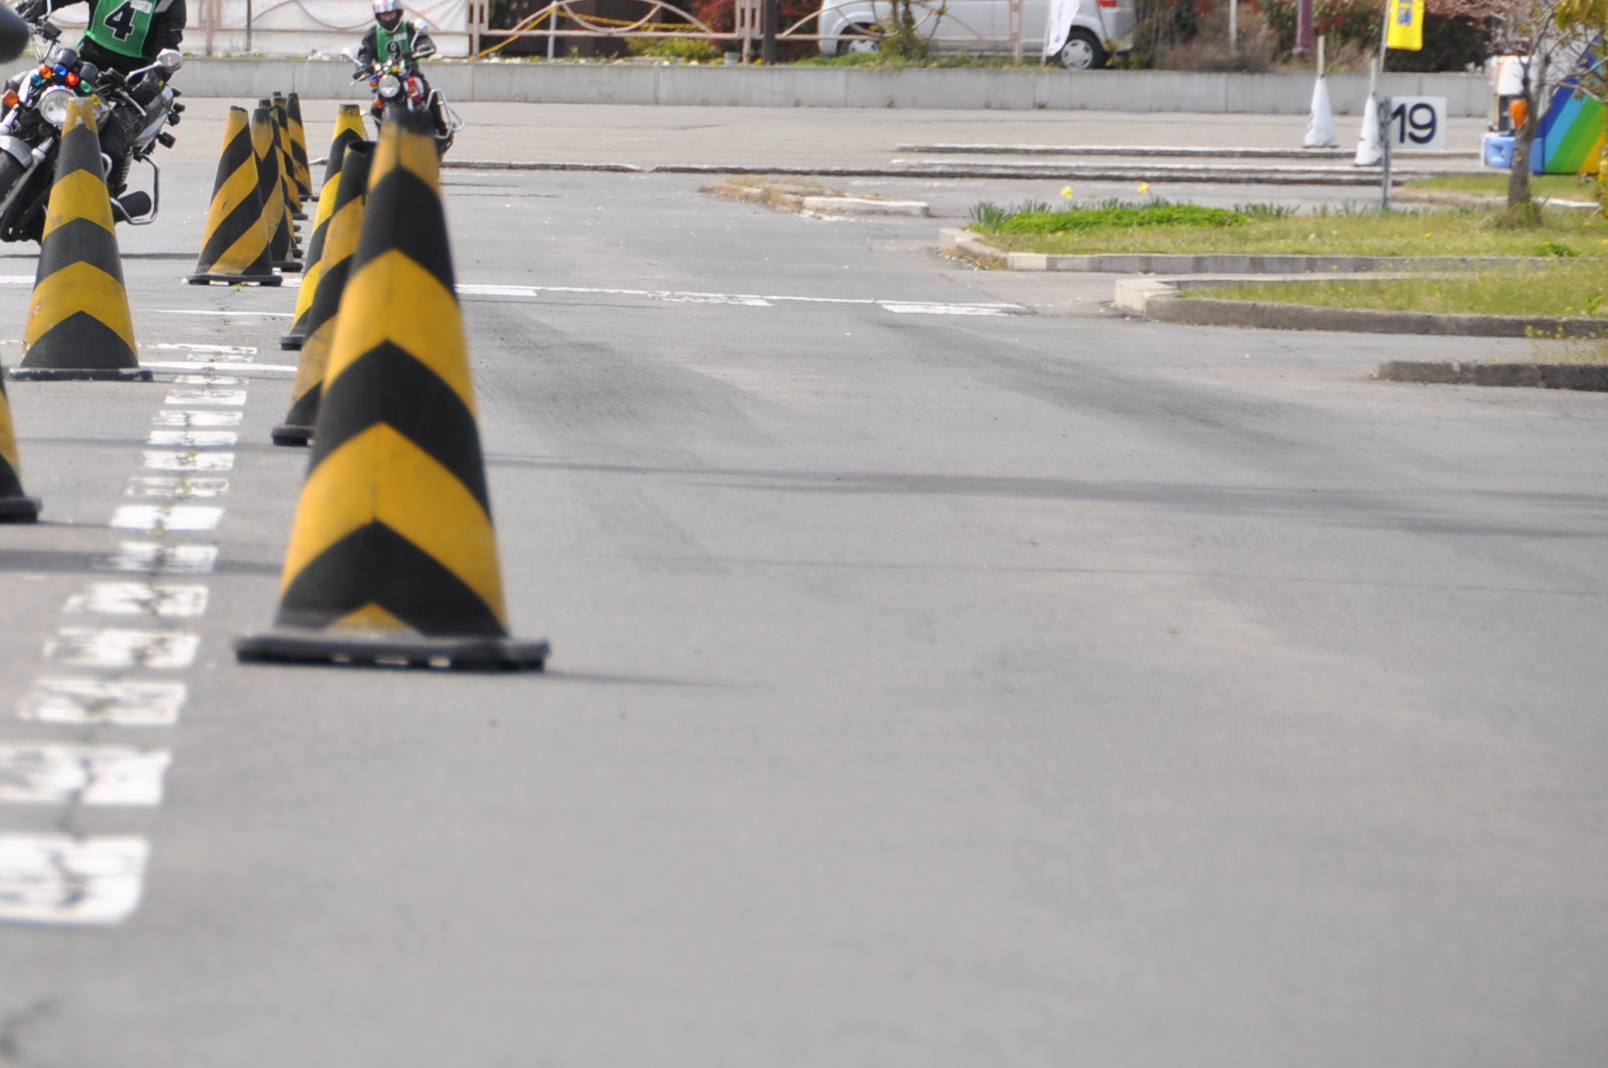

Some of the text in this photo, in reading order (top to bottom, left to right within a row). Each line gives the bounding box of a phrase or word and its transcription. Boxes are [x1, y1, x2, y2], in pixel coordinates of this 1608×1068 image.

[103, 0, 136, 42] 4
[385, 40, 401, 61] 9
[1392, 103, 1437, 144] 19
